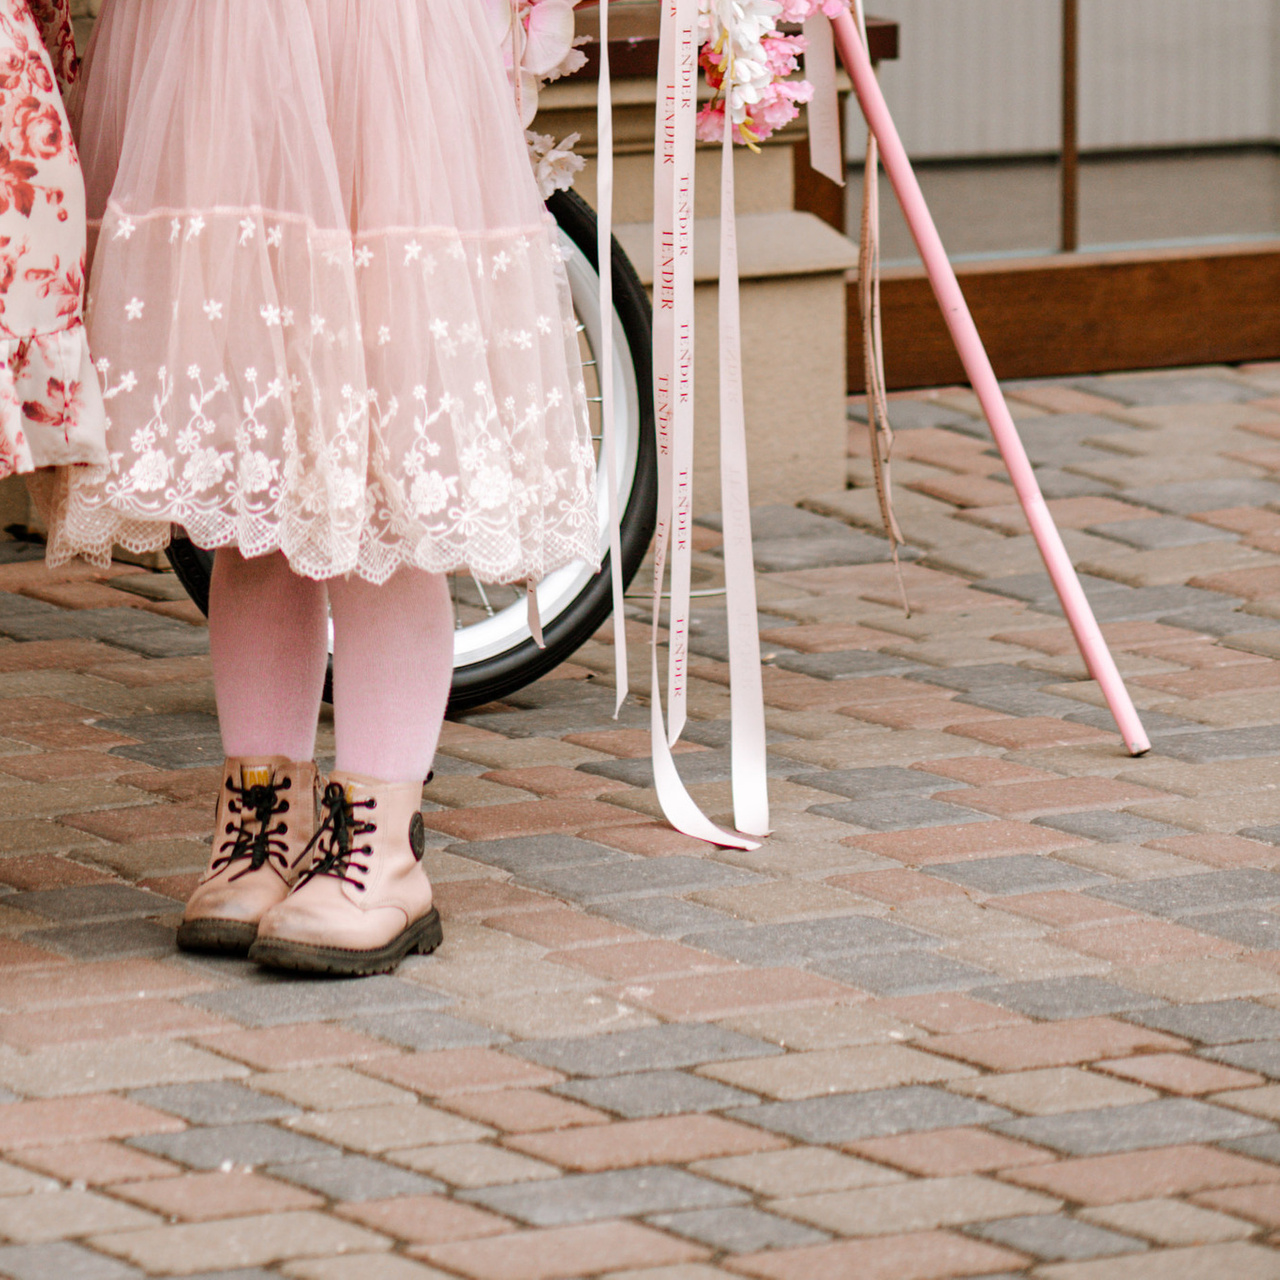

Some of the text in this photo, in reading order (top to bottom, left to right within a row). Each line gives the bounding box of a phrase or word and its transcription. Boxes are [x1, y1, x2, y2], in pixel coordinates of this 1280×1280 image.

[682, 26, 693, 109] TENDER
[678, 173, 689, 256] TENDER
[679, 321, 690, 403] TENDER
[658, 374, 669, 456] TENDER
[678, 468, 689, 551] TENDER
[674, 614, 685, 697] TENDER
